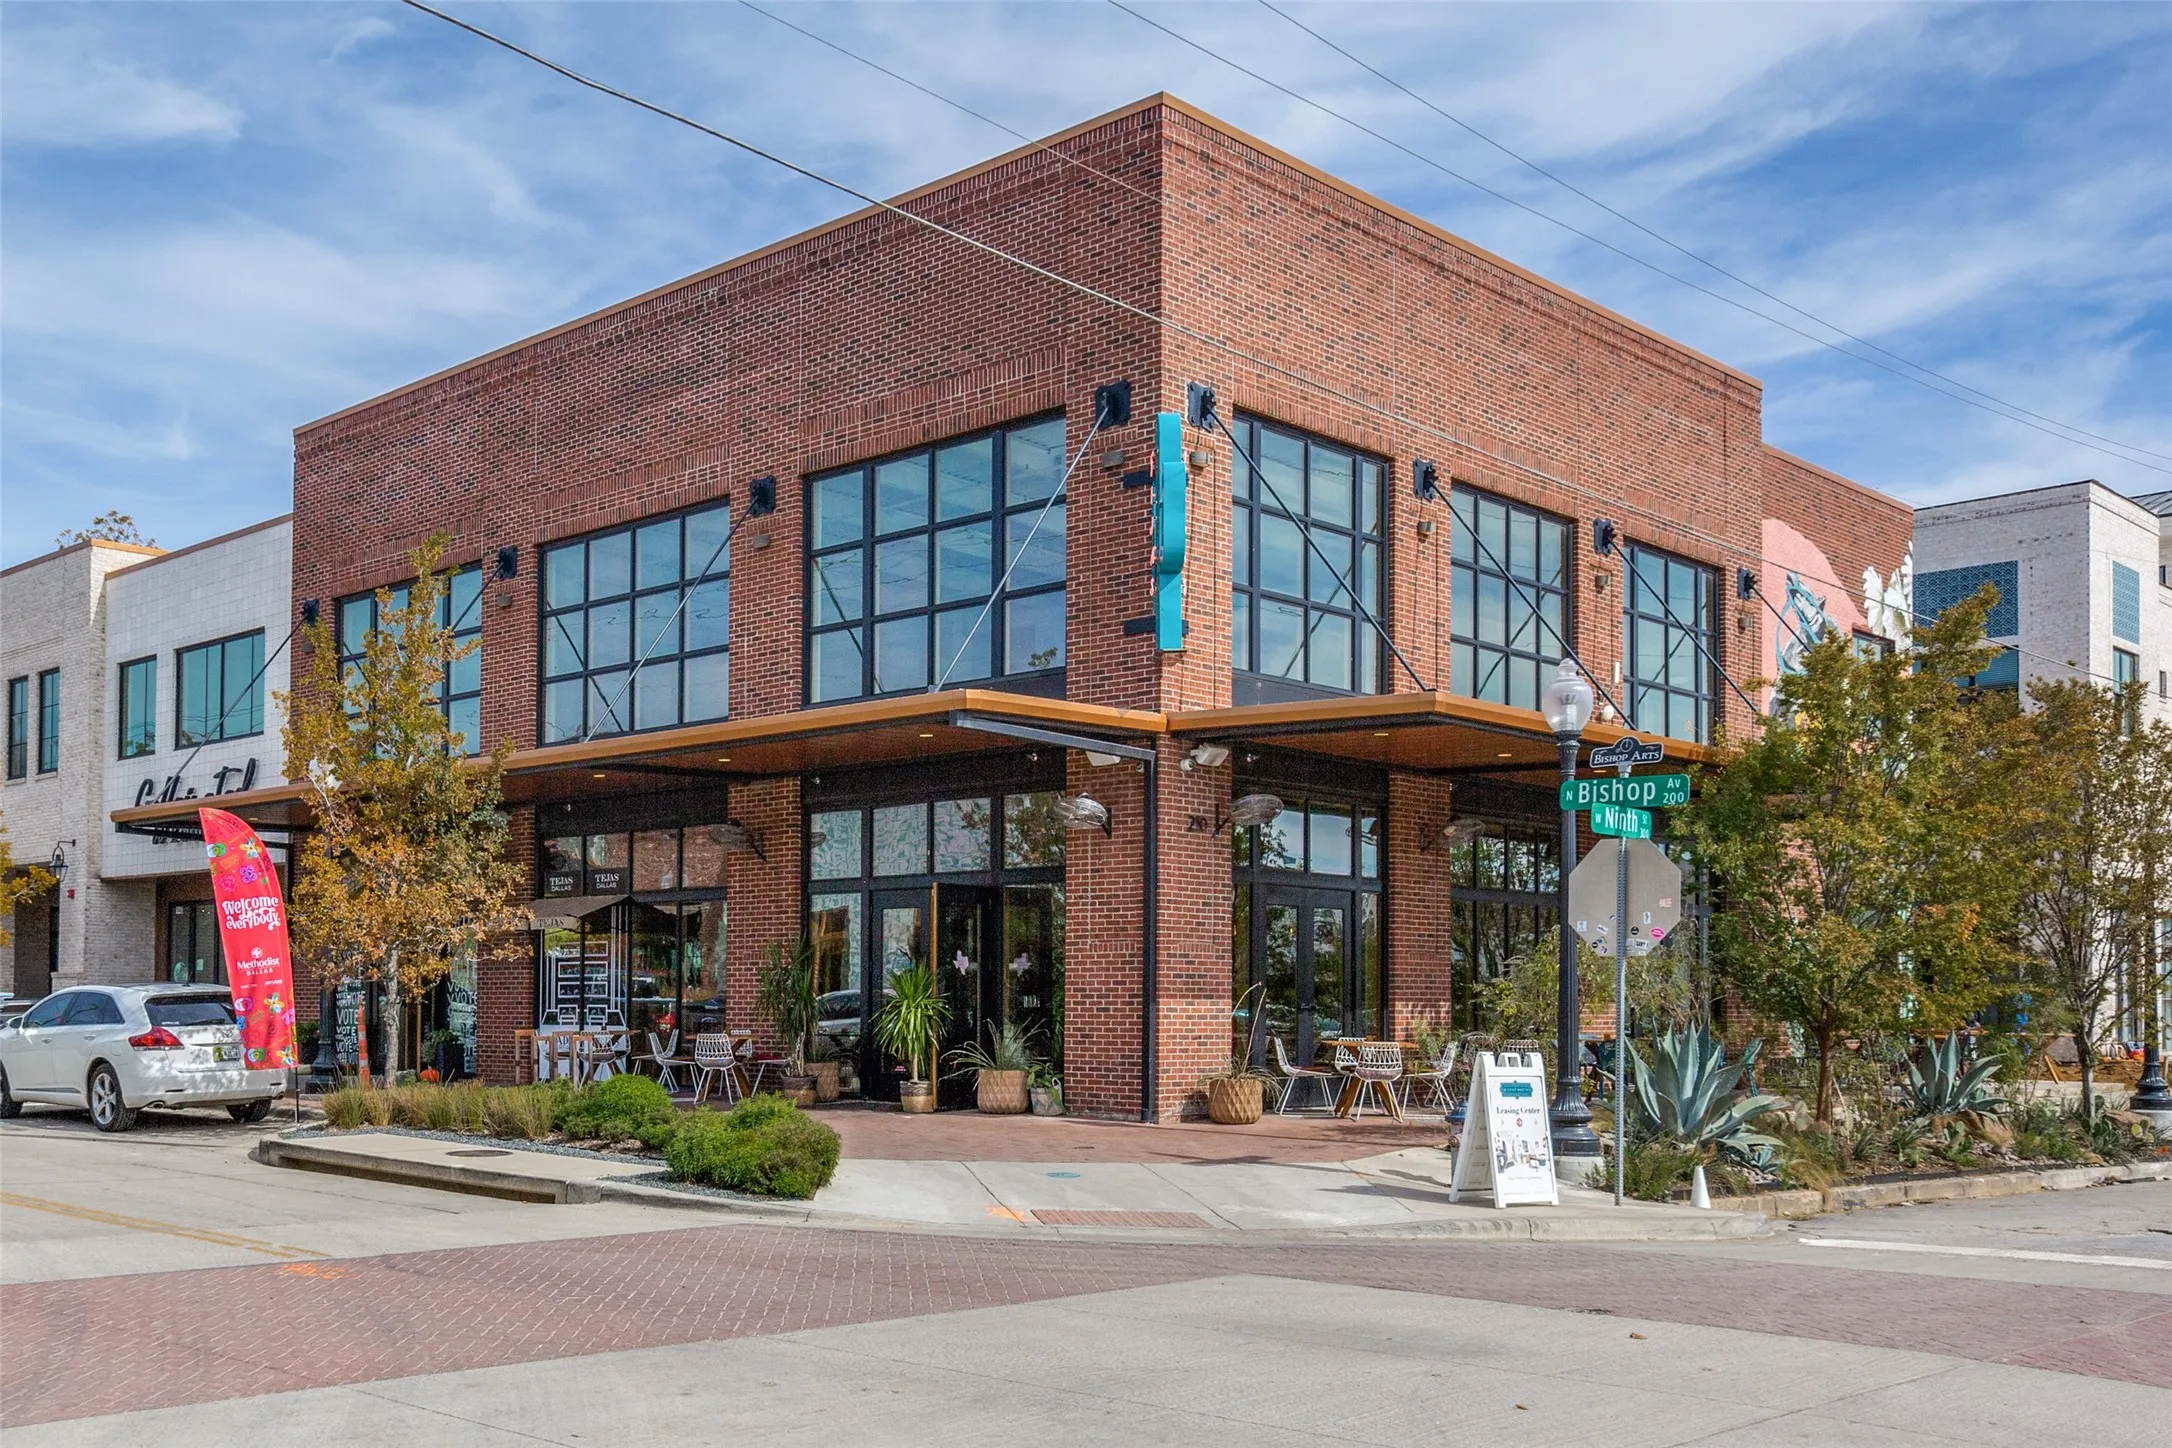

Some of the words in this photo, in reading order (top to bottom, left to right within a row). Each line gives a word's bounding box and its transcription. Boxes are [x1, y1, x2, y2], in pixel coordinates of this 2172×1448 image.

[1594, 754, 1628, 764] BISHOP
[1631, 751, 1660, 760] ARTS
[1566, 791, 1573, 800] N
[1578, 779, 1656, 806] Bishop
[1663, 792, 1685, 804] 200
[1595, 812, 1602, 823] W
[1605, 806, 1638, 832] Ninth
[549, 876, 574, 886] TEJAS
[595, 873, 620, 883] TEJAS
[222, 896, 279, 919] Welcome
[538, 918, 564, 928] TEJAS
[237, 957, 280, 970] Methodist
[246, 968, 273, 976] DALLAS
[337, 1009, 358, 1024] VOTE
[337, 1026, 356, 1035] VOTE
[336, 1042, 353, 1052] VOTE
[1496, 1106, 1519, 1115] Leasing
